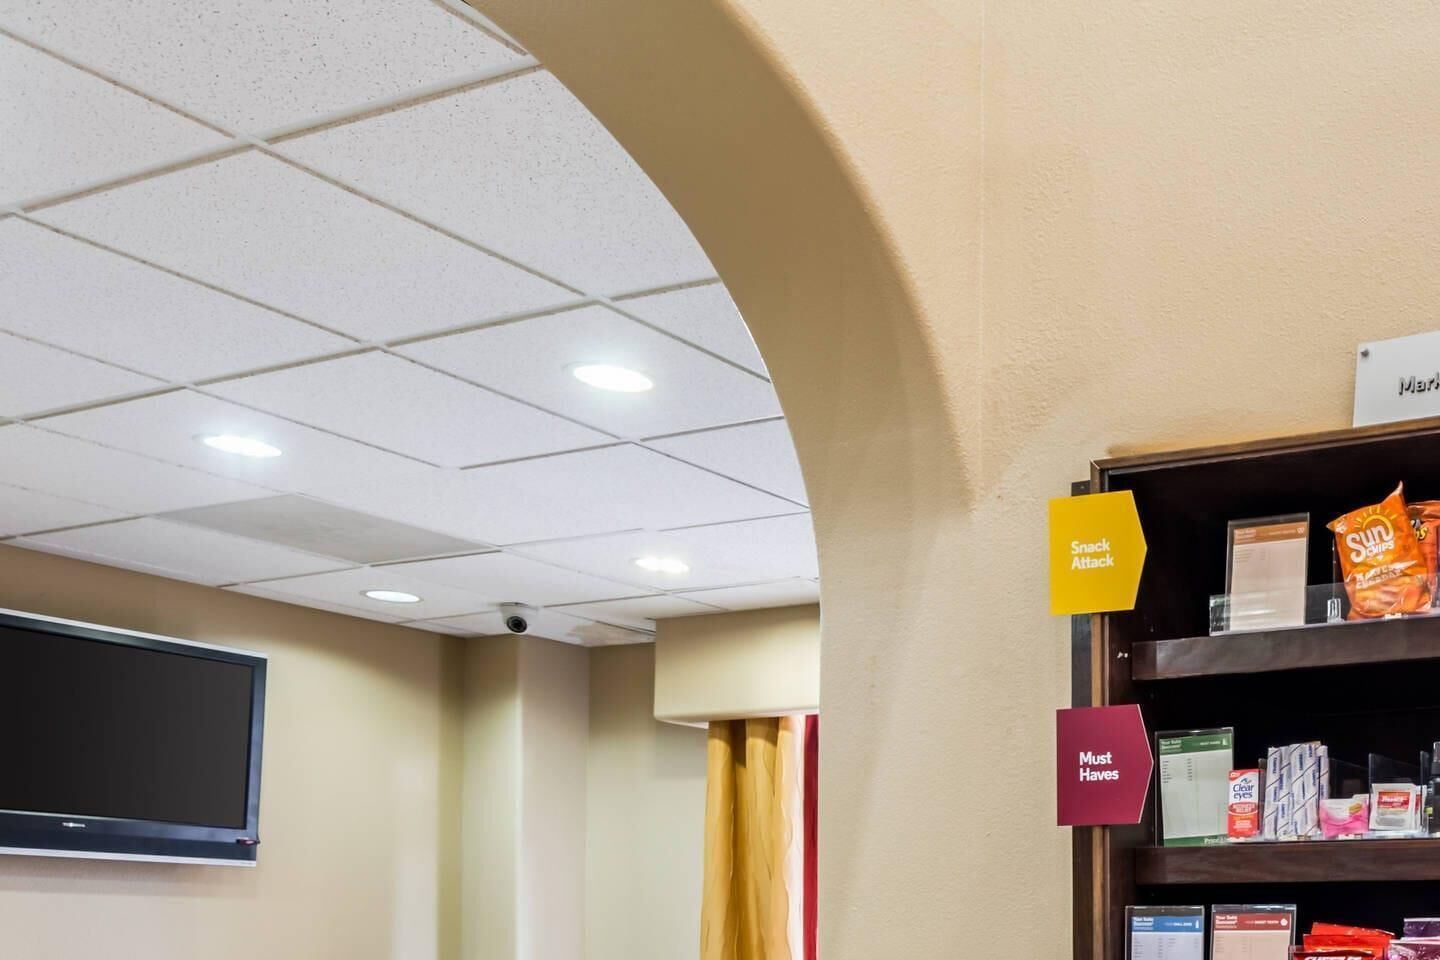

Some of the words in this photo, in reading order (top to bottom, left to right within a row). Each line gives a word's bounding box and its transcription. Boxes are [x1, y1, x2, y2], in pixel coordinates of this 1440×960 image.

[1071, 538, 1110, 555] Snack
[1346, 525, 1394, 563] Sun
[1071, 554, 1114, 570] Attack
[1079, 751, 1112, 766] Must
[1079, 767, 1119, 782] Haves
[1233, 783, 1255, 793] Clear
[1233, 792, 1253, 801] eyes
